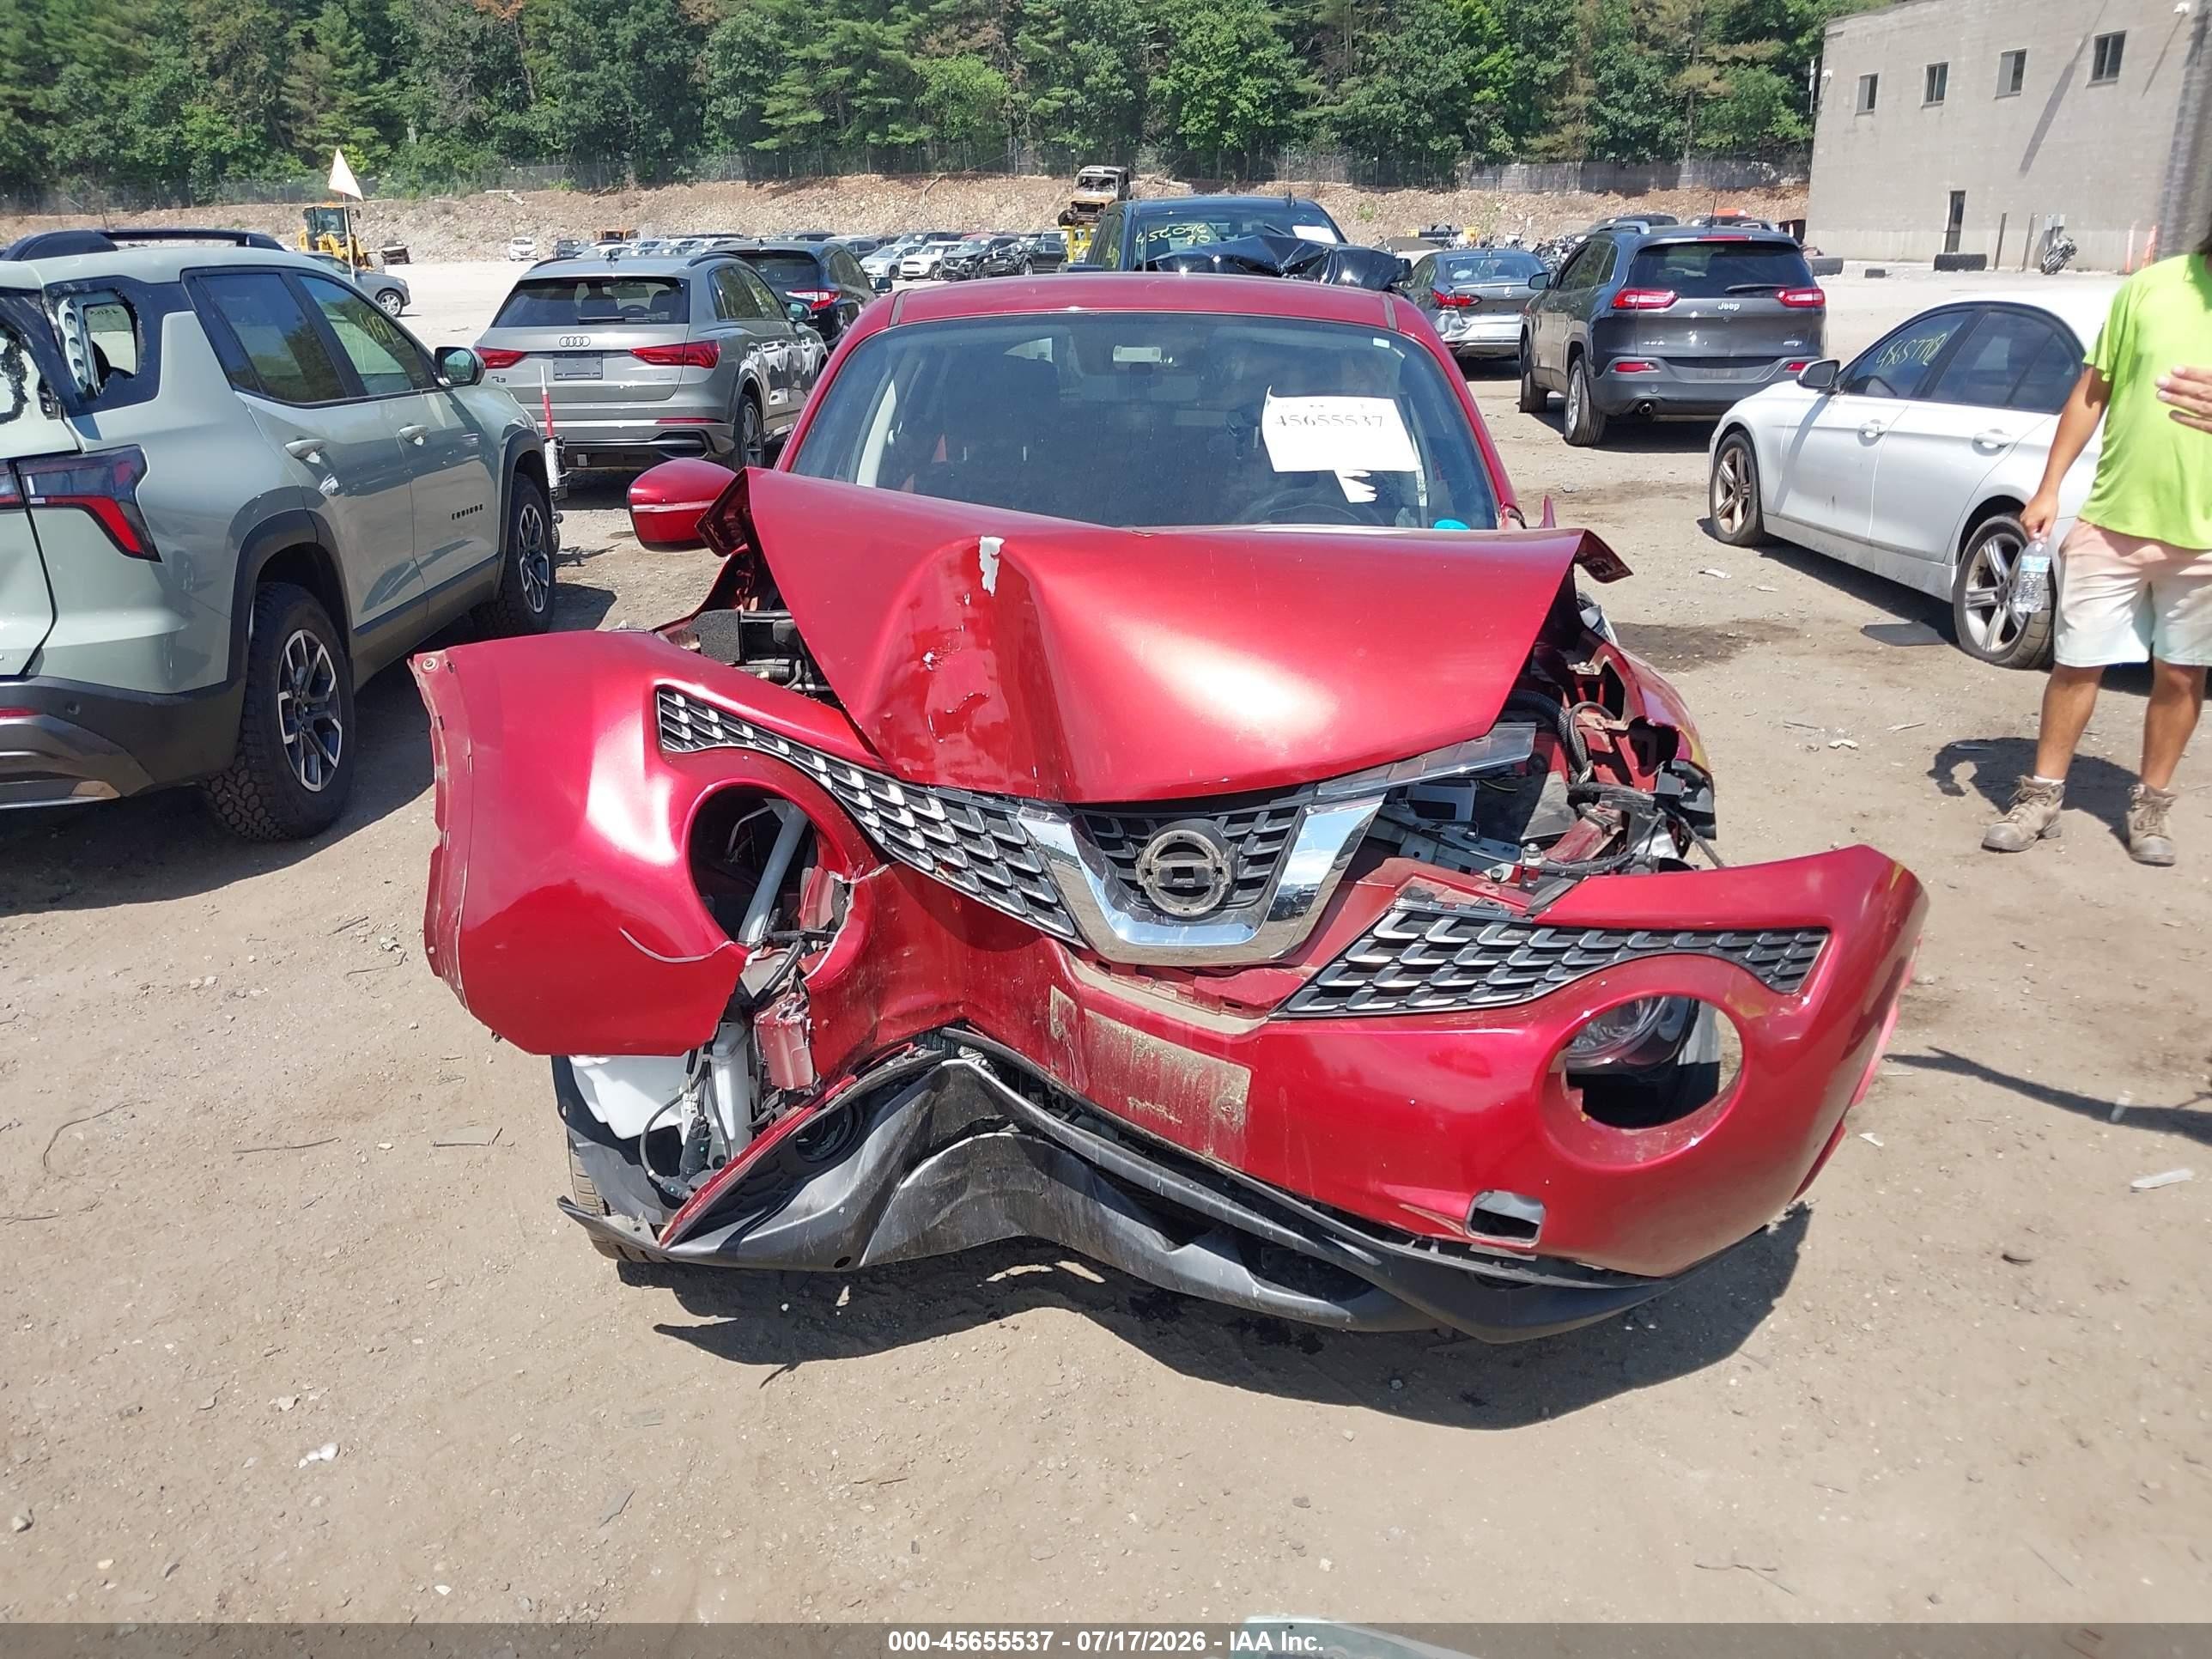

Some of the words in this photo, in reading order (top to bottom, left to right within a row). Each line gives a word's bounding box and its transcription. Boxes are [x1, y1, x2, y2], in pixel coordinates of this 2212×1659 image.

[1186, 234, 1211, 246] 80
[1717, 301, 1741, 312] Jeep
[1275, 415, 1382, 427] 45655537
